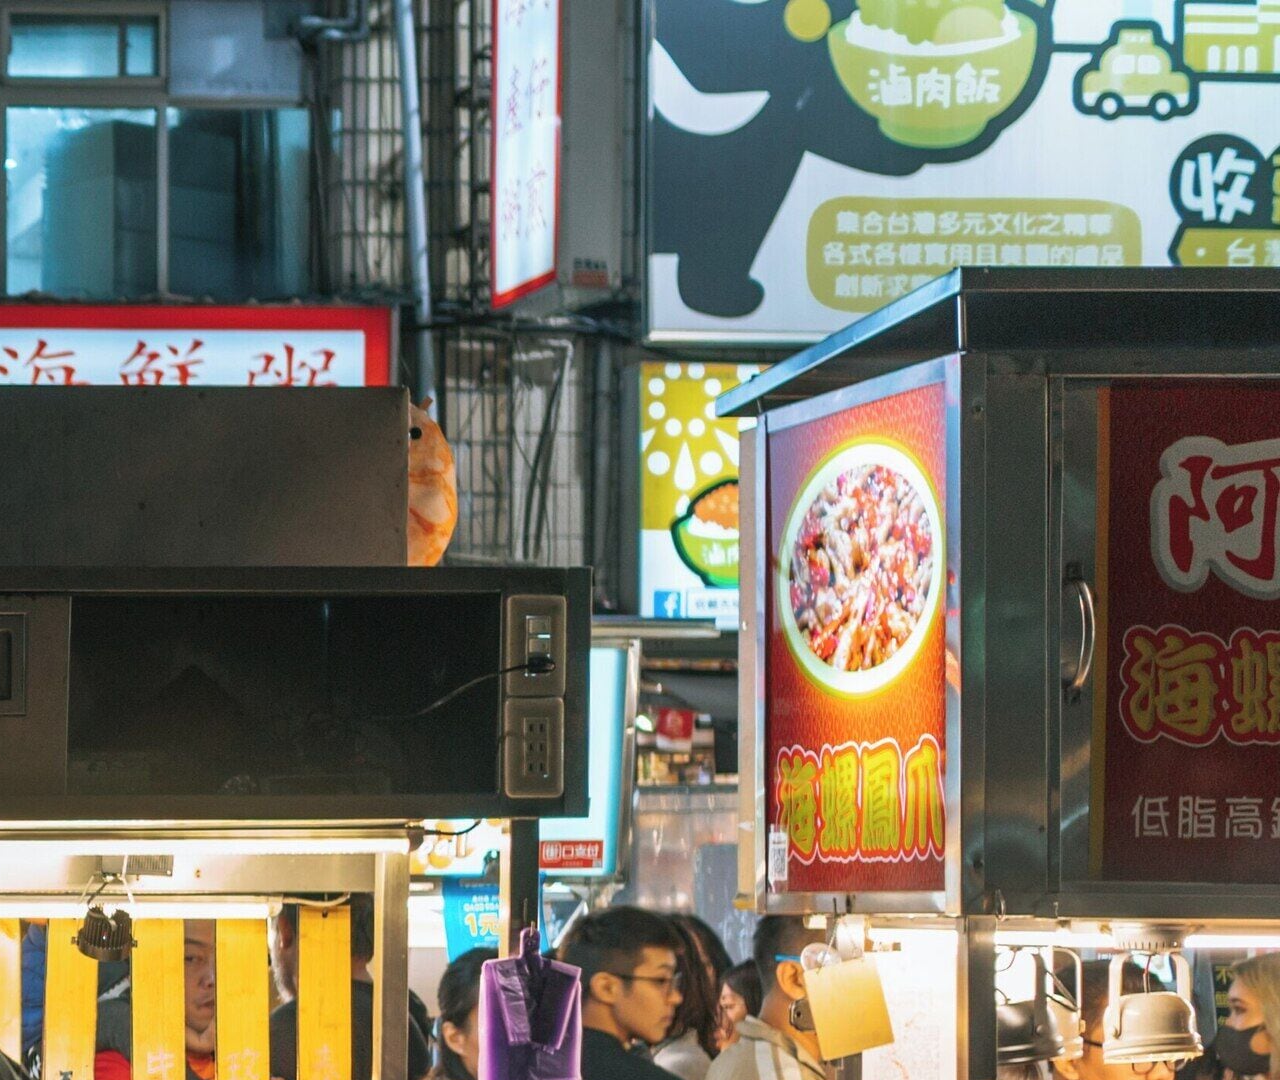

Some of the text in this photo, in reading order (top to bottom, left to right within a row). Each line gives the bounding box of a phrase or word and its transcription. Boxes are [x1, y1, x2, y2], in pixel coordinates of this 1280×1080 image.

[867, 61, 1001, 109] 滷肉飯
[778, 740, 945, 857] 海螺鳳爪
